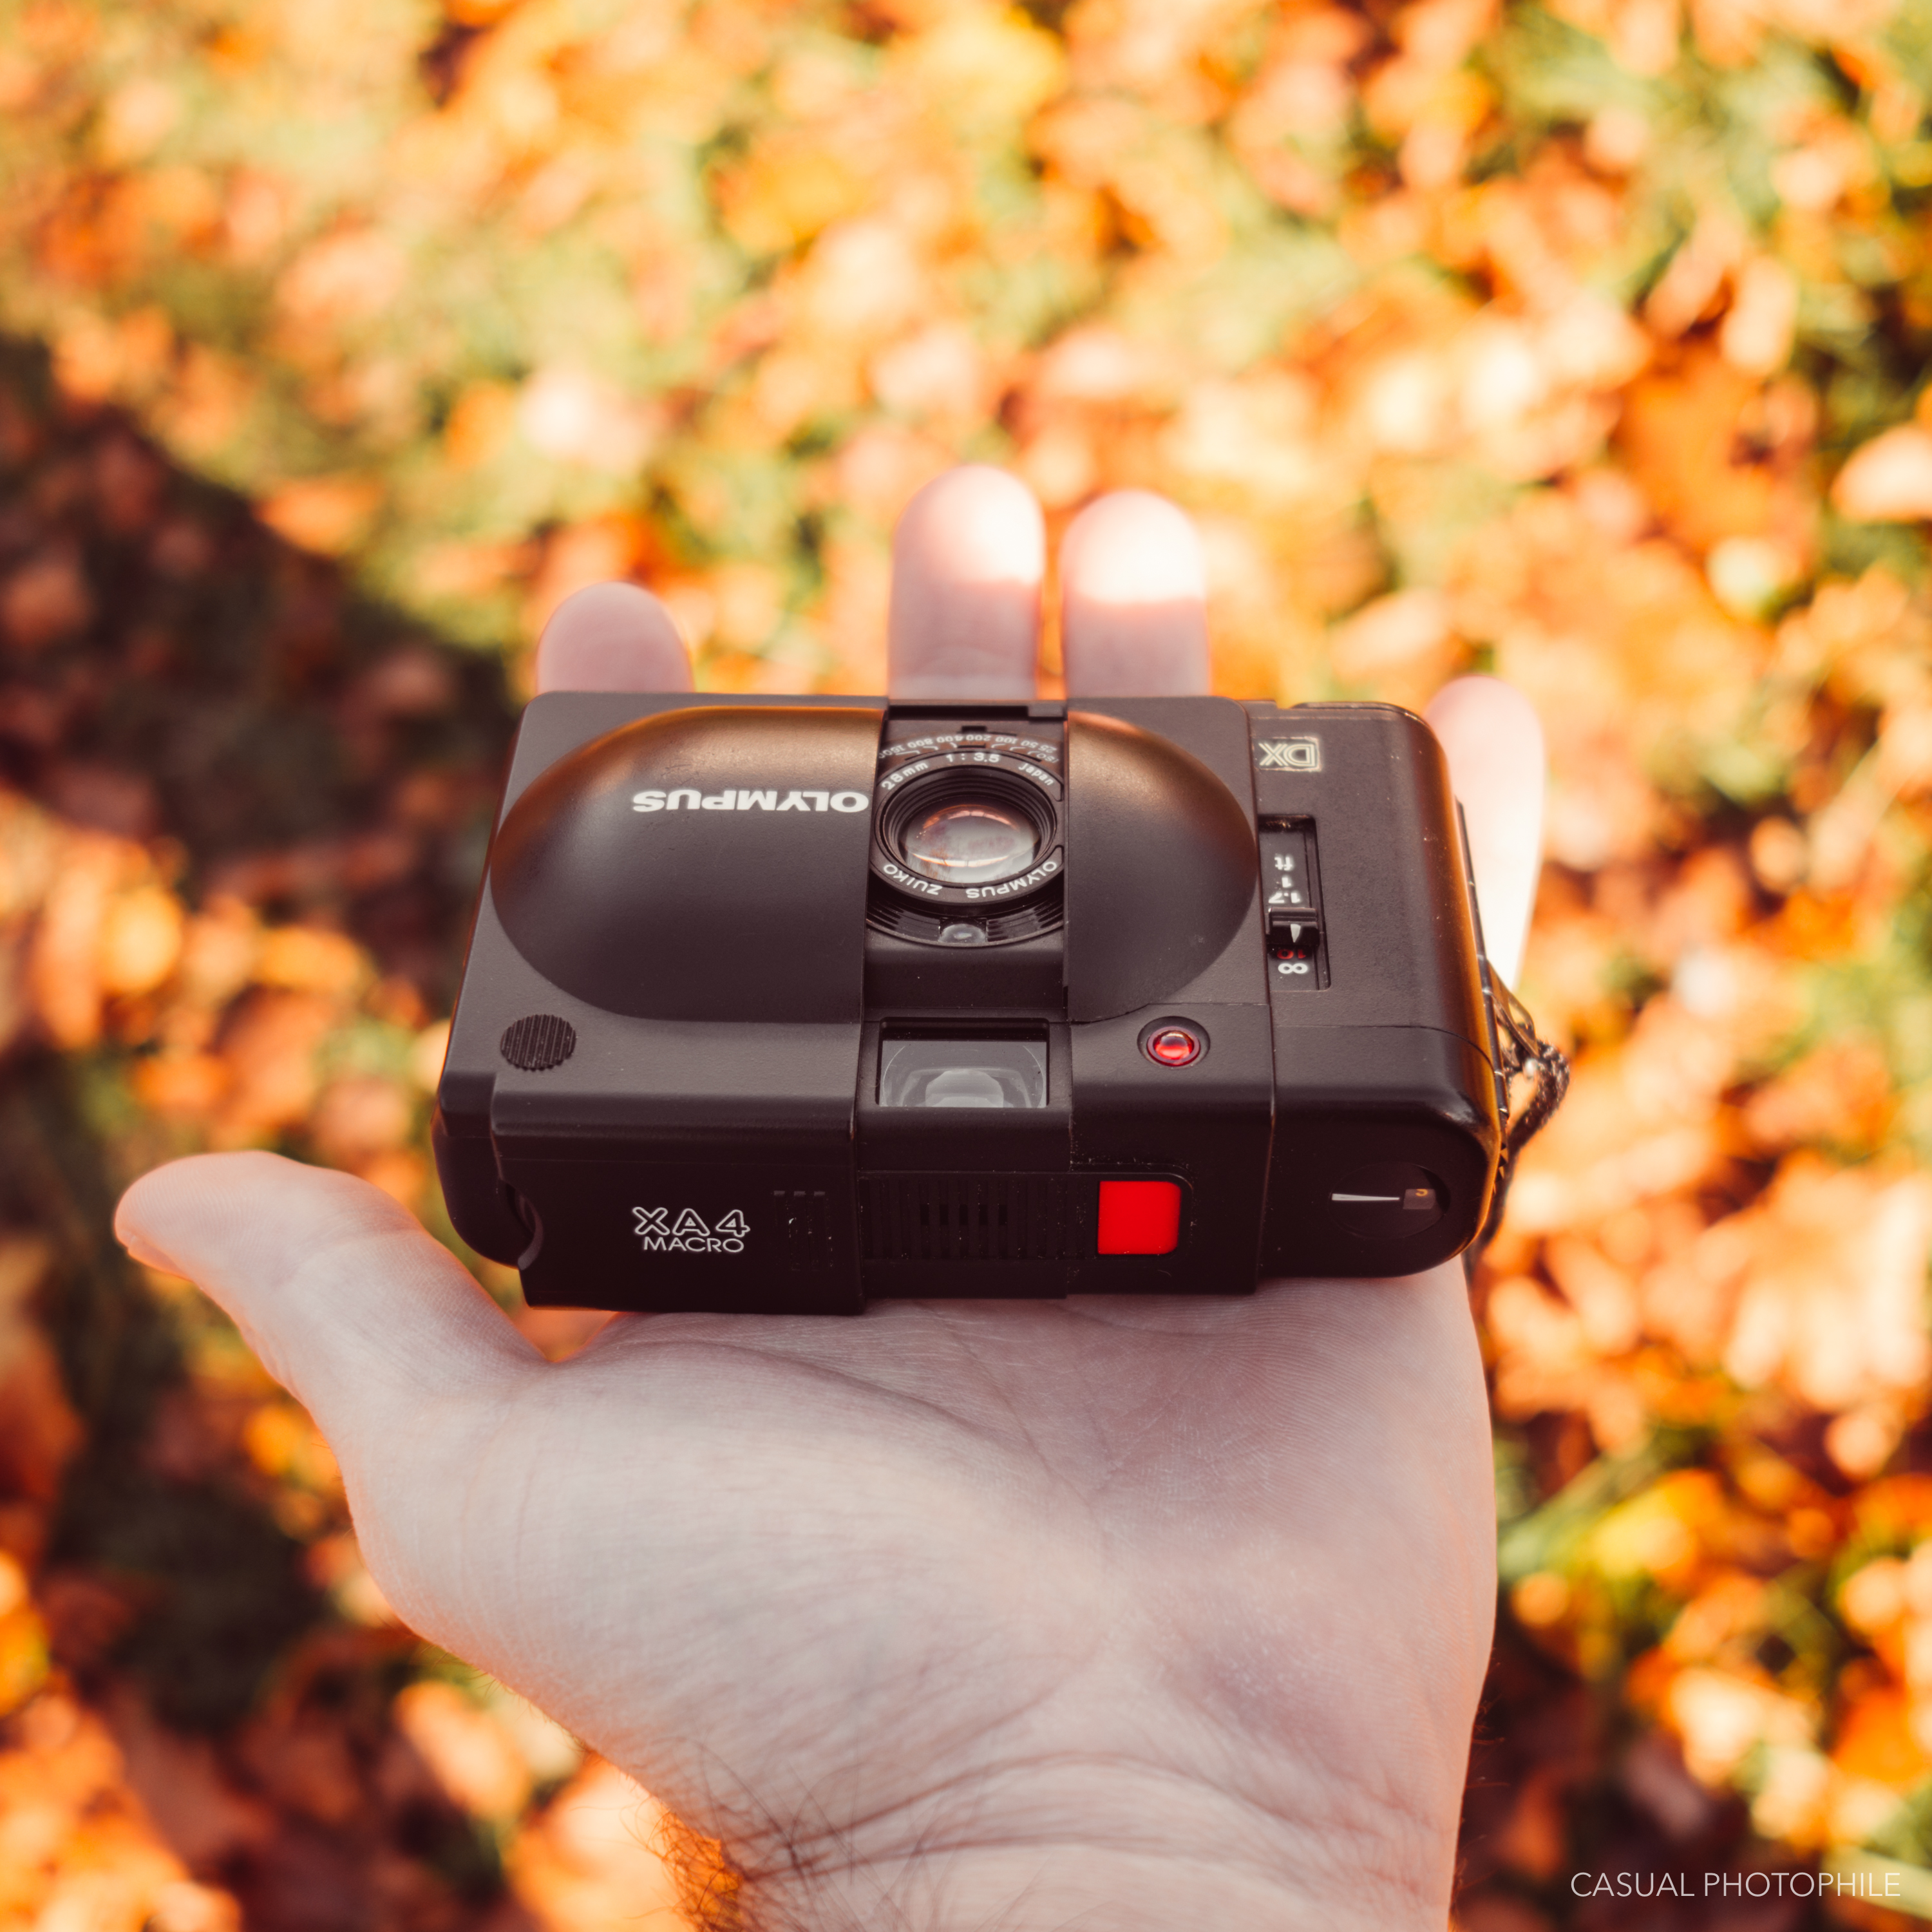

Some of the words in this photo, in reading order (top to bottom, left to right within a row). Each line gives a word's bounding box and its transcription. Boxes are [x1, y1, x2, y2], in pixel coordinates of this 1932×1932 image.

[907, 738, 933, 748] 800
[995, 735, 1018, 744] 100
[1039, 744, 1057, 753] 25
[1258, 743, 1316, 766] DX
[1037, 753, 1059, 762] ISO
[633, 789, 869, 813] OLYMPUS
[1274, 856, 1293, 871] ft
[882, 864, 943, 896] ZUIKO
[965, 860, 1057, 899] OLYMPUS
[1282, 877, 1291, 888] 1
[1268, 892, 1302, 904] 1.7
[1276, 949, 1307, 960] 10
[643, 1236, 744, 1253] MACRO
